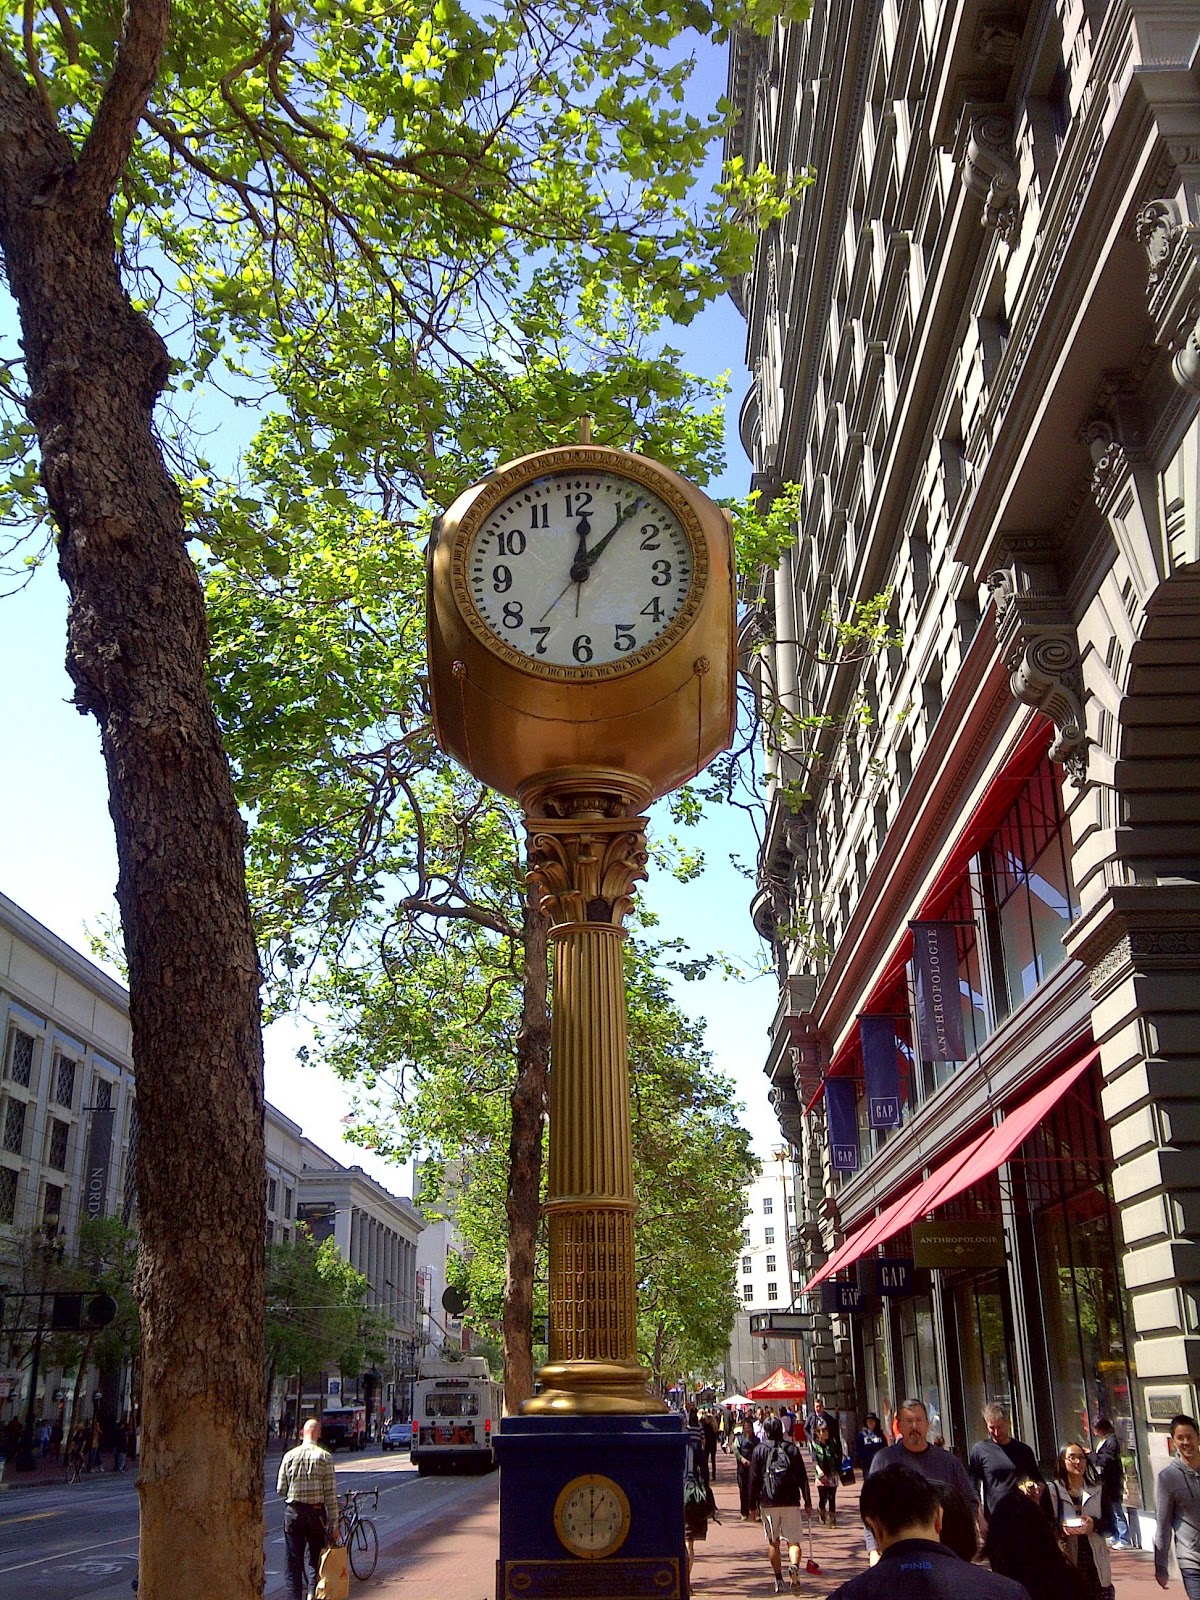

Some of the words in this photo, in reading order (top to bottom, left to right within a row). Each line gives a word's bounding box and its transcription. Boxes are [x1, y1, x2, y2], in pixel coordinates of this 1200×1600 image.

[530, 503, 550, 529] 11
[565, 492, 594, 517] 12
[497, 530, 527, 556] 10
[640, 524, 660, 551] 2
[492, 565, 513, 593] 9
[651, 559, 672, 586] 3
[502, 601, 524, 629] 8
[640, 597, 665, 623] 4
[530, 627, 551, 654] 7
[572, 635, 593, 663] 6
[613, 624, 636, 651] 5
[928, 929, 947, 1056] ANTHROPOLOGIE
[876, 1105, 893, 1118] GAP
[838, 1151, 853, 1162] GAP
[920, 1236, 998, 1244] ANTHROPOLOGIE
[881, 1266, 906, 1287] GAP
[842, 1292, 859, 1306] GAP
[900, 1561, 932, 1571] PING
